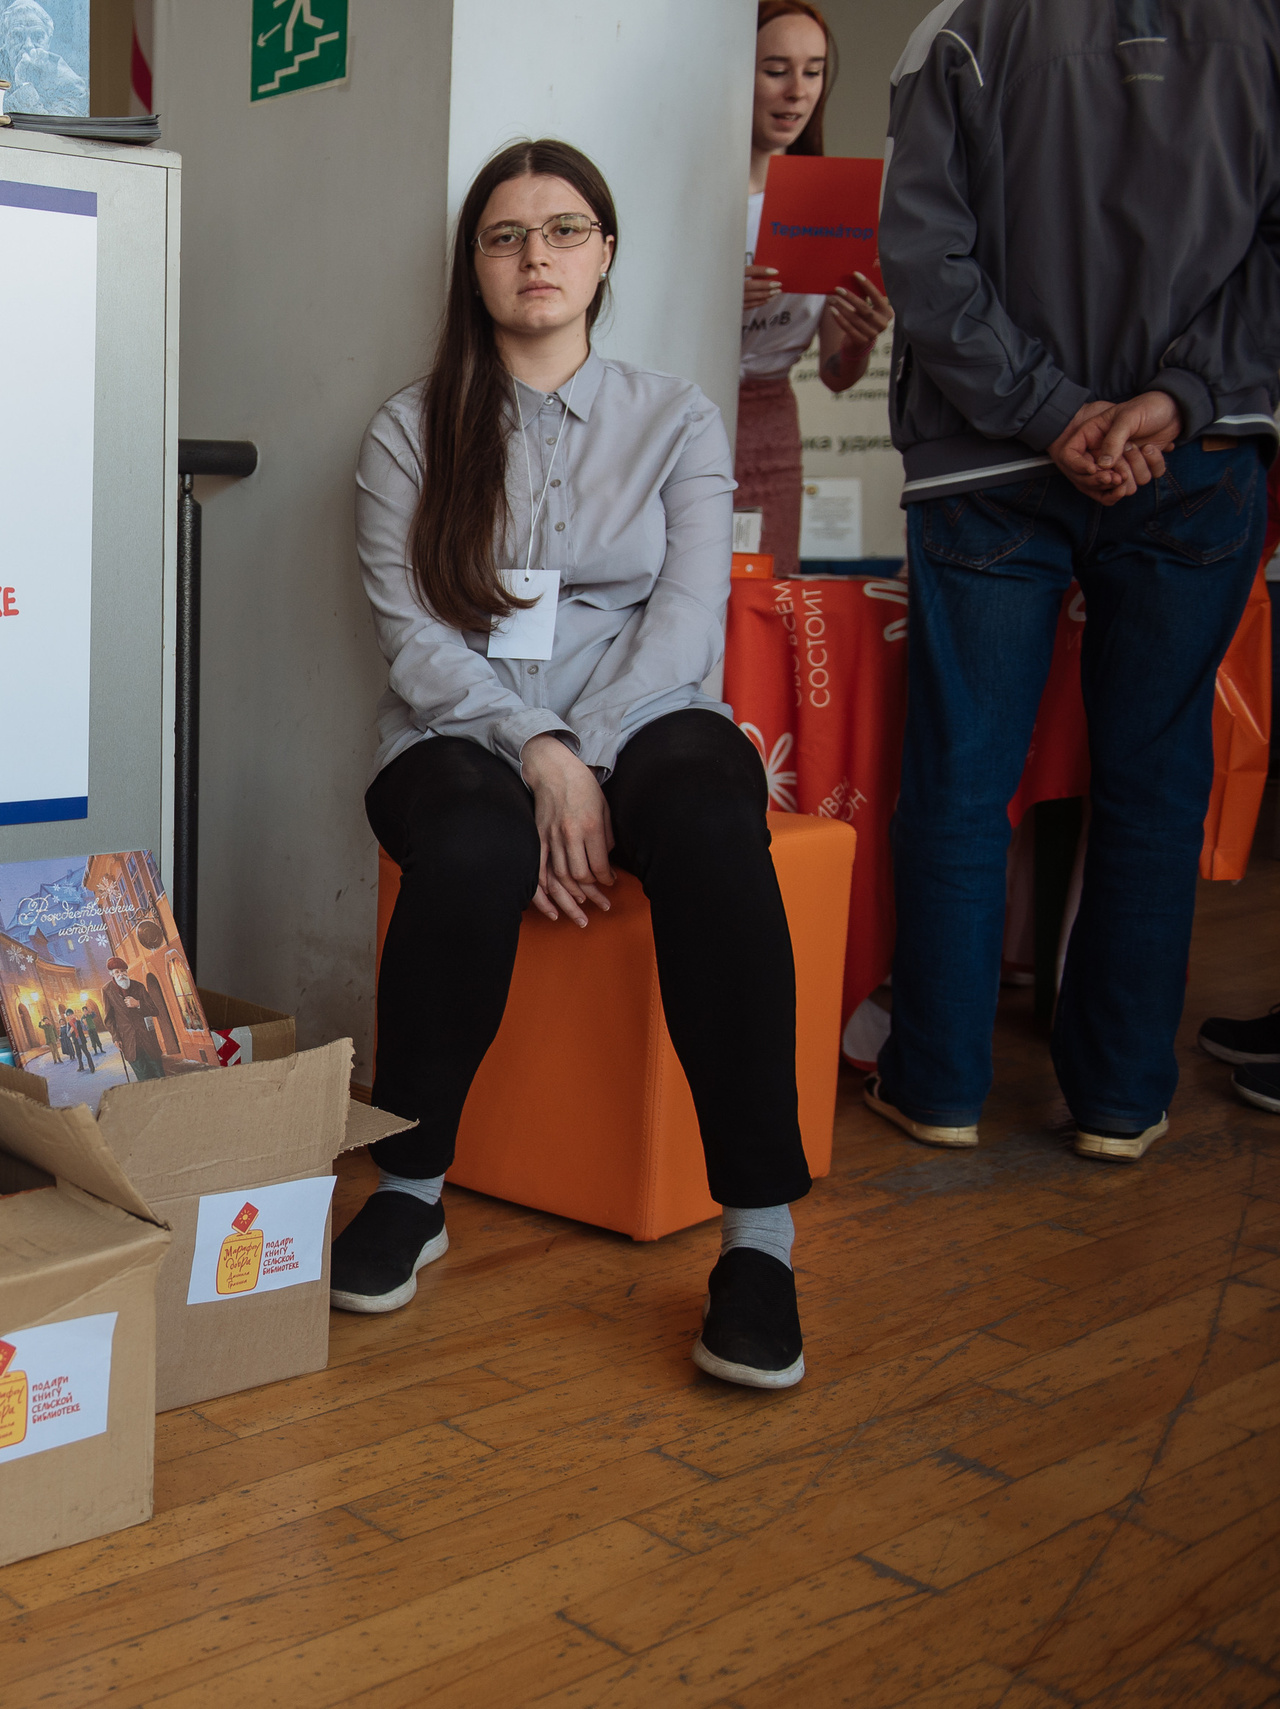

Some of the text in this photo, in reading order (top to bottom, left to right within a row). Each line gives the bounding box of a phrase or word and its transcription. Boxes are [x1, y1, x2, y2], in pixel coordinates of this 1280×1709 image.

[802, 589, 830, 708] СОСТОИТ
[18, 894, 135, 926] Рождественские
[263, 1252, 295, 1267] СЕЛЬСКОЙ
[263, 1262, 299, 1275] БИБЛИОТЕКЕ
[32, 1392, 73, 1414] СЕЛЬСКОЙ
[32, 1403, 81, 1424] БИБЛИОТЕКЕ
